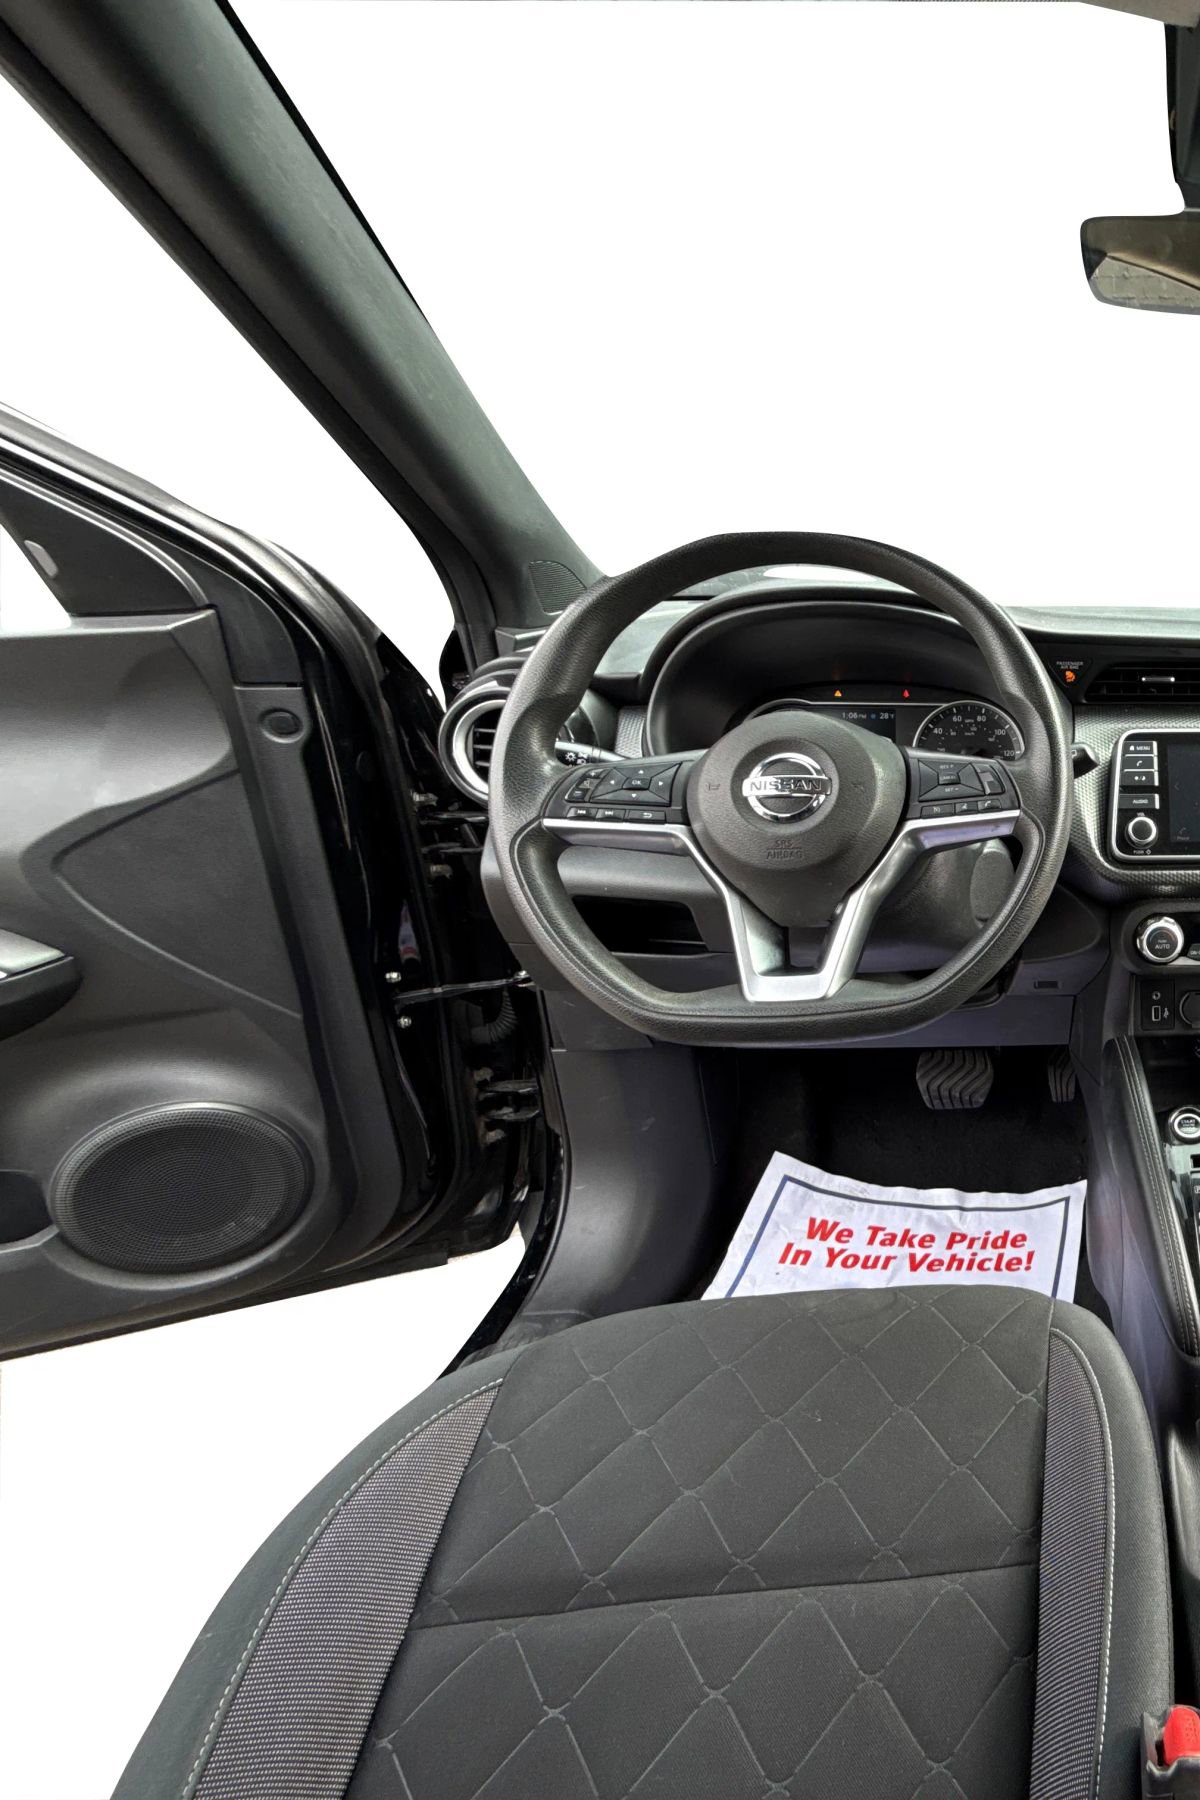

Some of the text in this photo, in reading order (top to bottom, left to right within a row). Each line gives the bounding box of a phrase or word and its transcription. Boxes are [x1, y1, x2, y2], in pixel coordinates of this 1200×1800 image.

[933, 727, 943, 735] 40
[750, 779, 822, 791] NISSAN
[775, 839, 793, 848] SRS
[805, 1216, 1028, 1250] We Take Pride
[778, 1242, 1036, 1273] In Your Vehicle!
